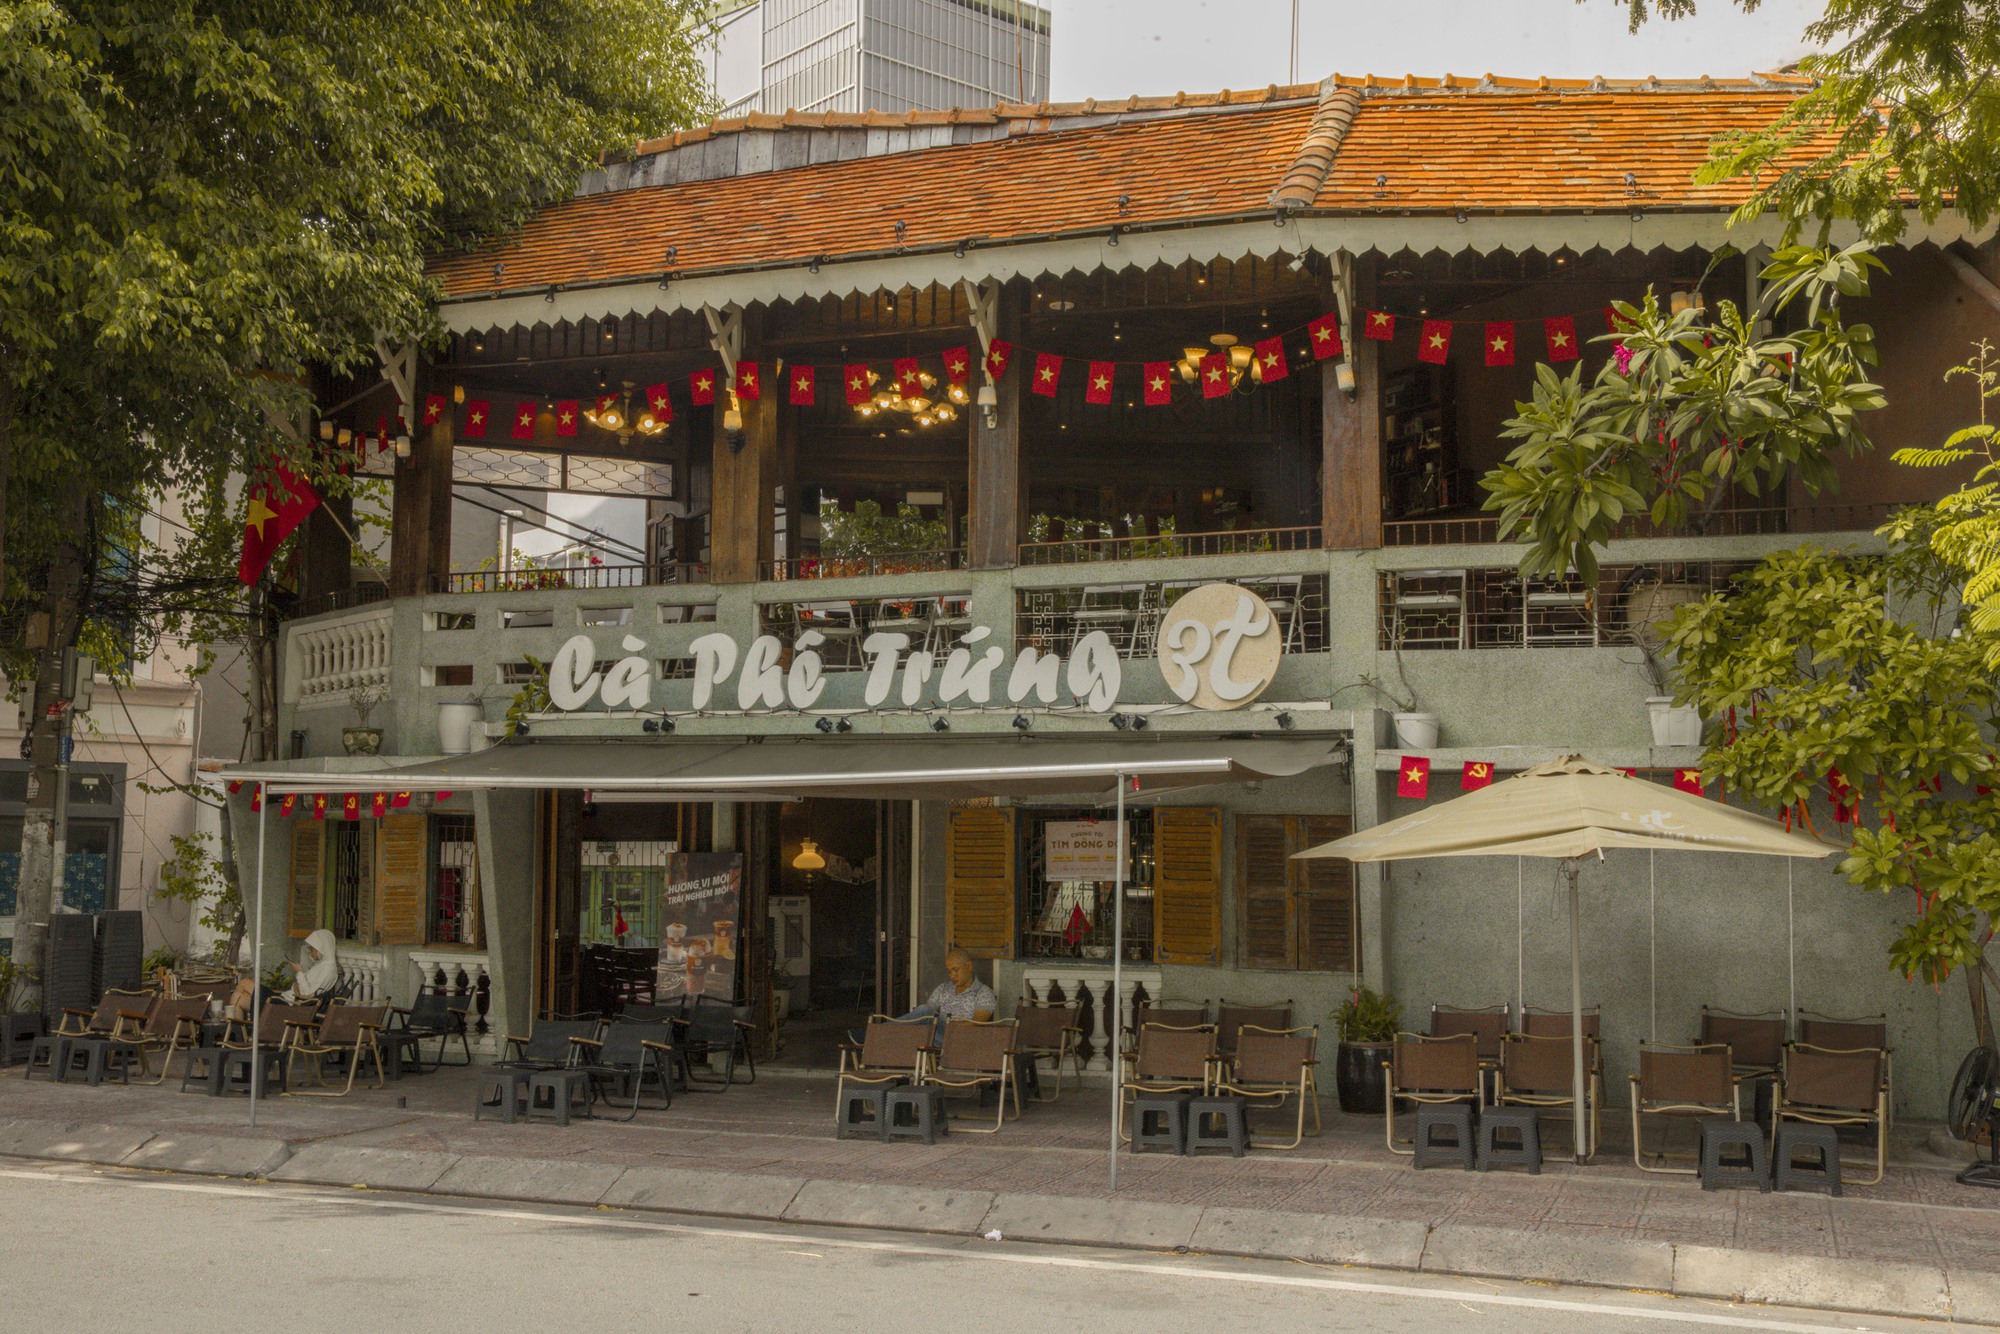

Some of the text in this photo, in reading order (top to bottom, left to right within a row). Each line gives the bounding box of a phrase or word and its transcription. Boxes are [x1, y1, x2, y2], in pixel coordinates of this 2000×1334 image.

[549, 625, 1122, 713] Cà Phê Trứng
